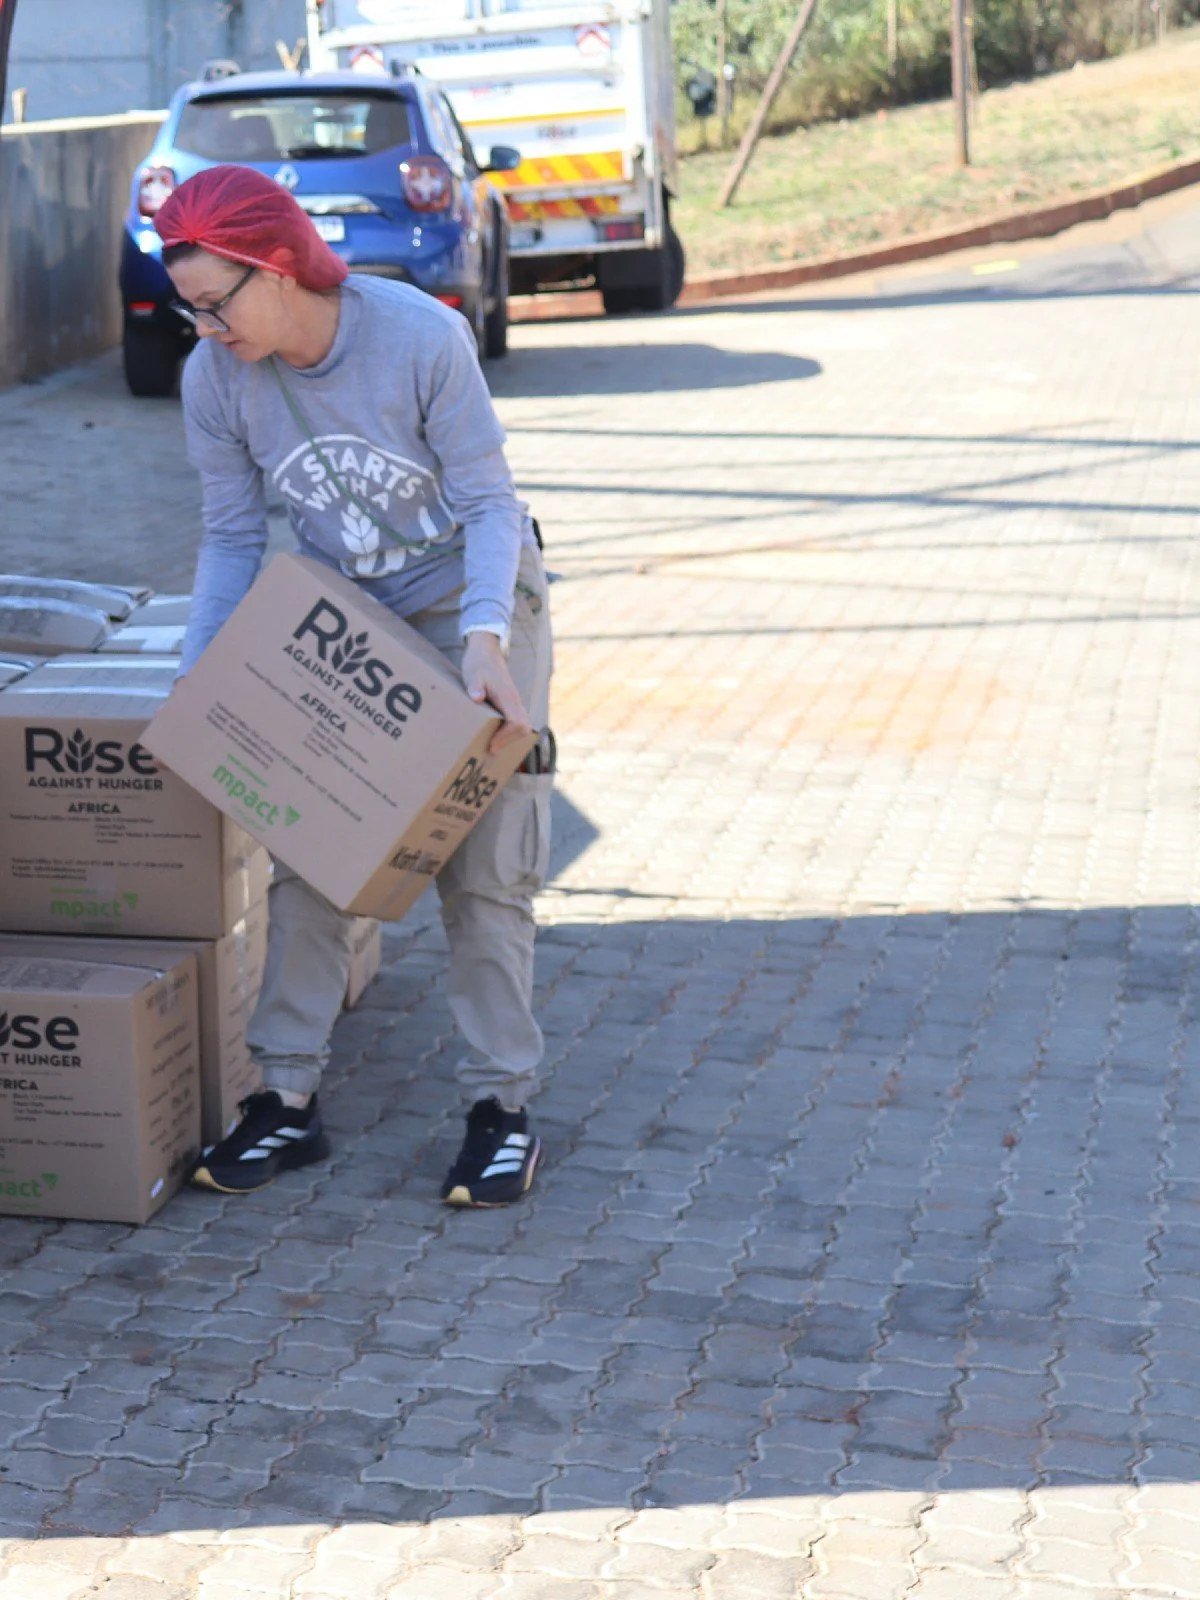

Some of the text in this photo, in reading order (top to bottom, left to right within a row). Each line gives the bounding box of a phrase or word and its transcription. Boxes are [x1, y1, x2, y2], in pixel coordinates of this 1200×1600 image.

[302, 447, 424, 499] STARTS
[283, 643, 343, 692] AGAINST
[343, 688, 402, 741] HUNGER
[300, 692, 348, 734] AFRICA
[28, 777, 163, 791] AGAINST HUNGER
[68, 802, 122, 814] AFRICA
[15, 1053, 82, 1068] HUNGER
